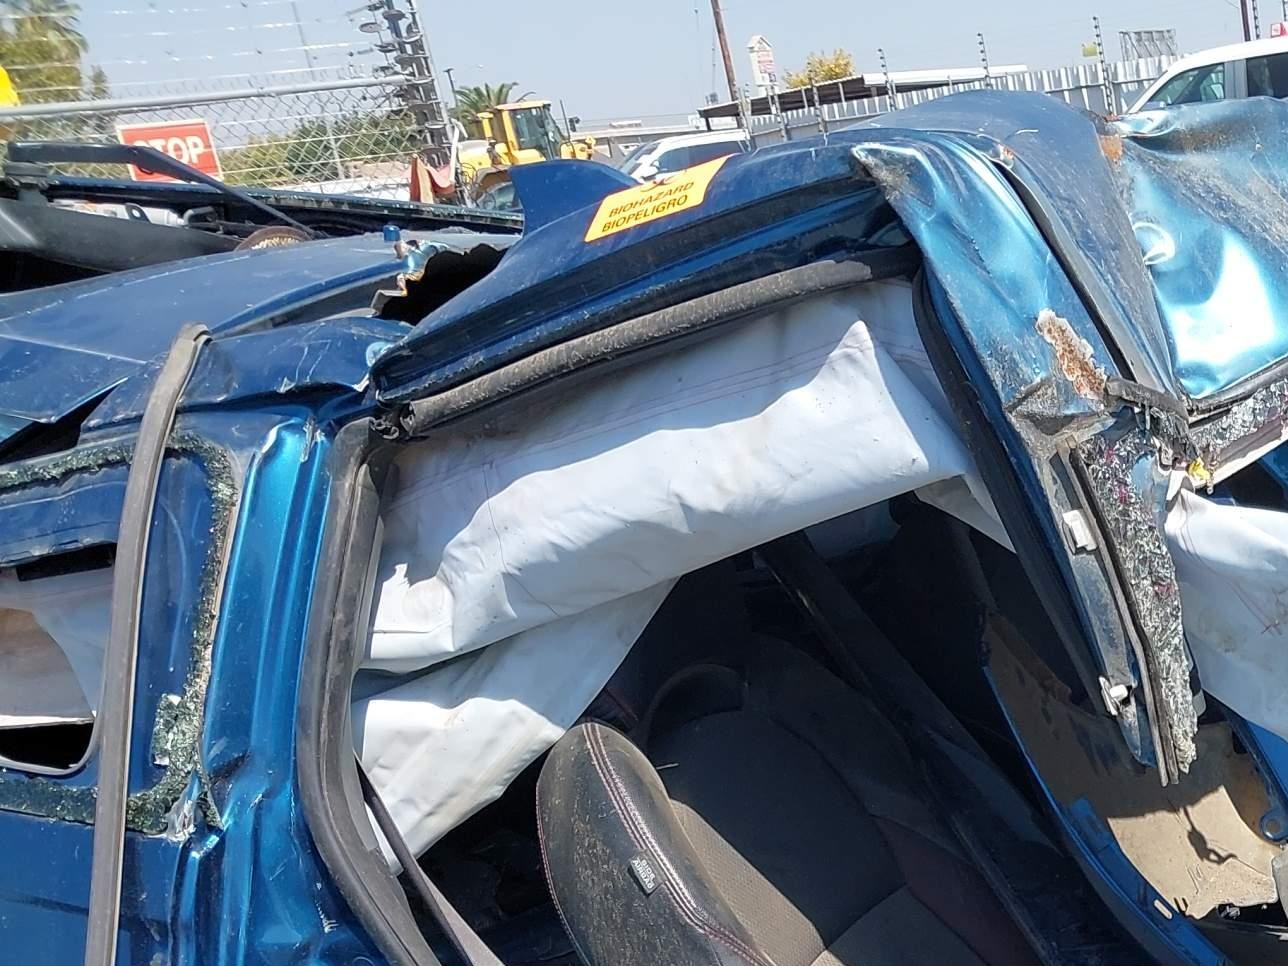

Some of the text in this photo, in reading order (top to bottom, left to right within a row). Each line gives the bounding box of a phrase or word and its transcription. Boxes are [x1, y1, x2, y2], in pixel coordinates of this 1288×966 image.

[134, 135, 206, 164] TOP
[601, 194, 689, 233] BIOPELIGRO
[608, 181, 695, 218] BIOHAZARD
